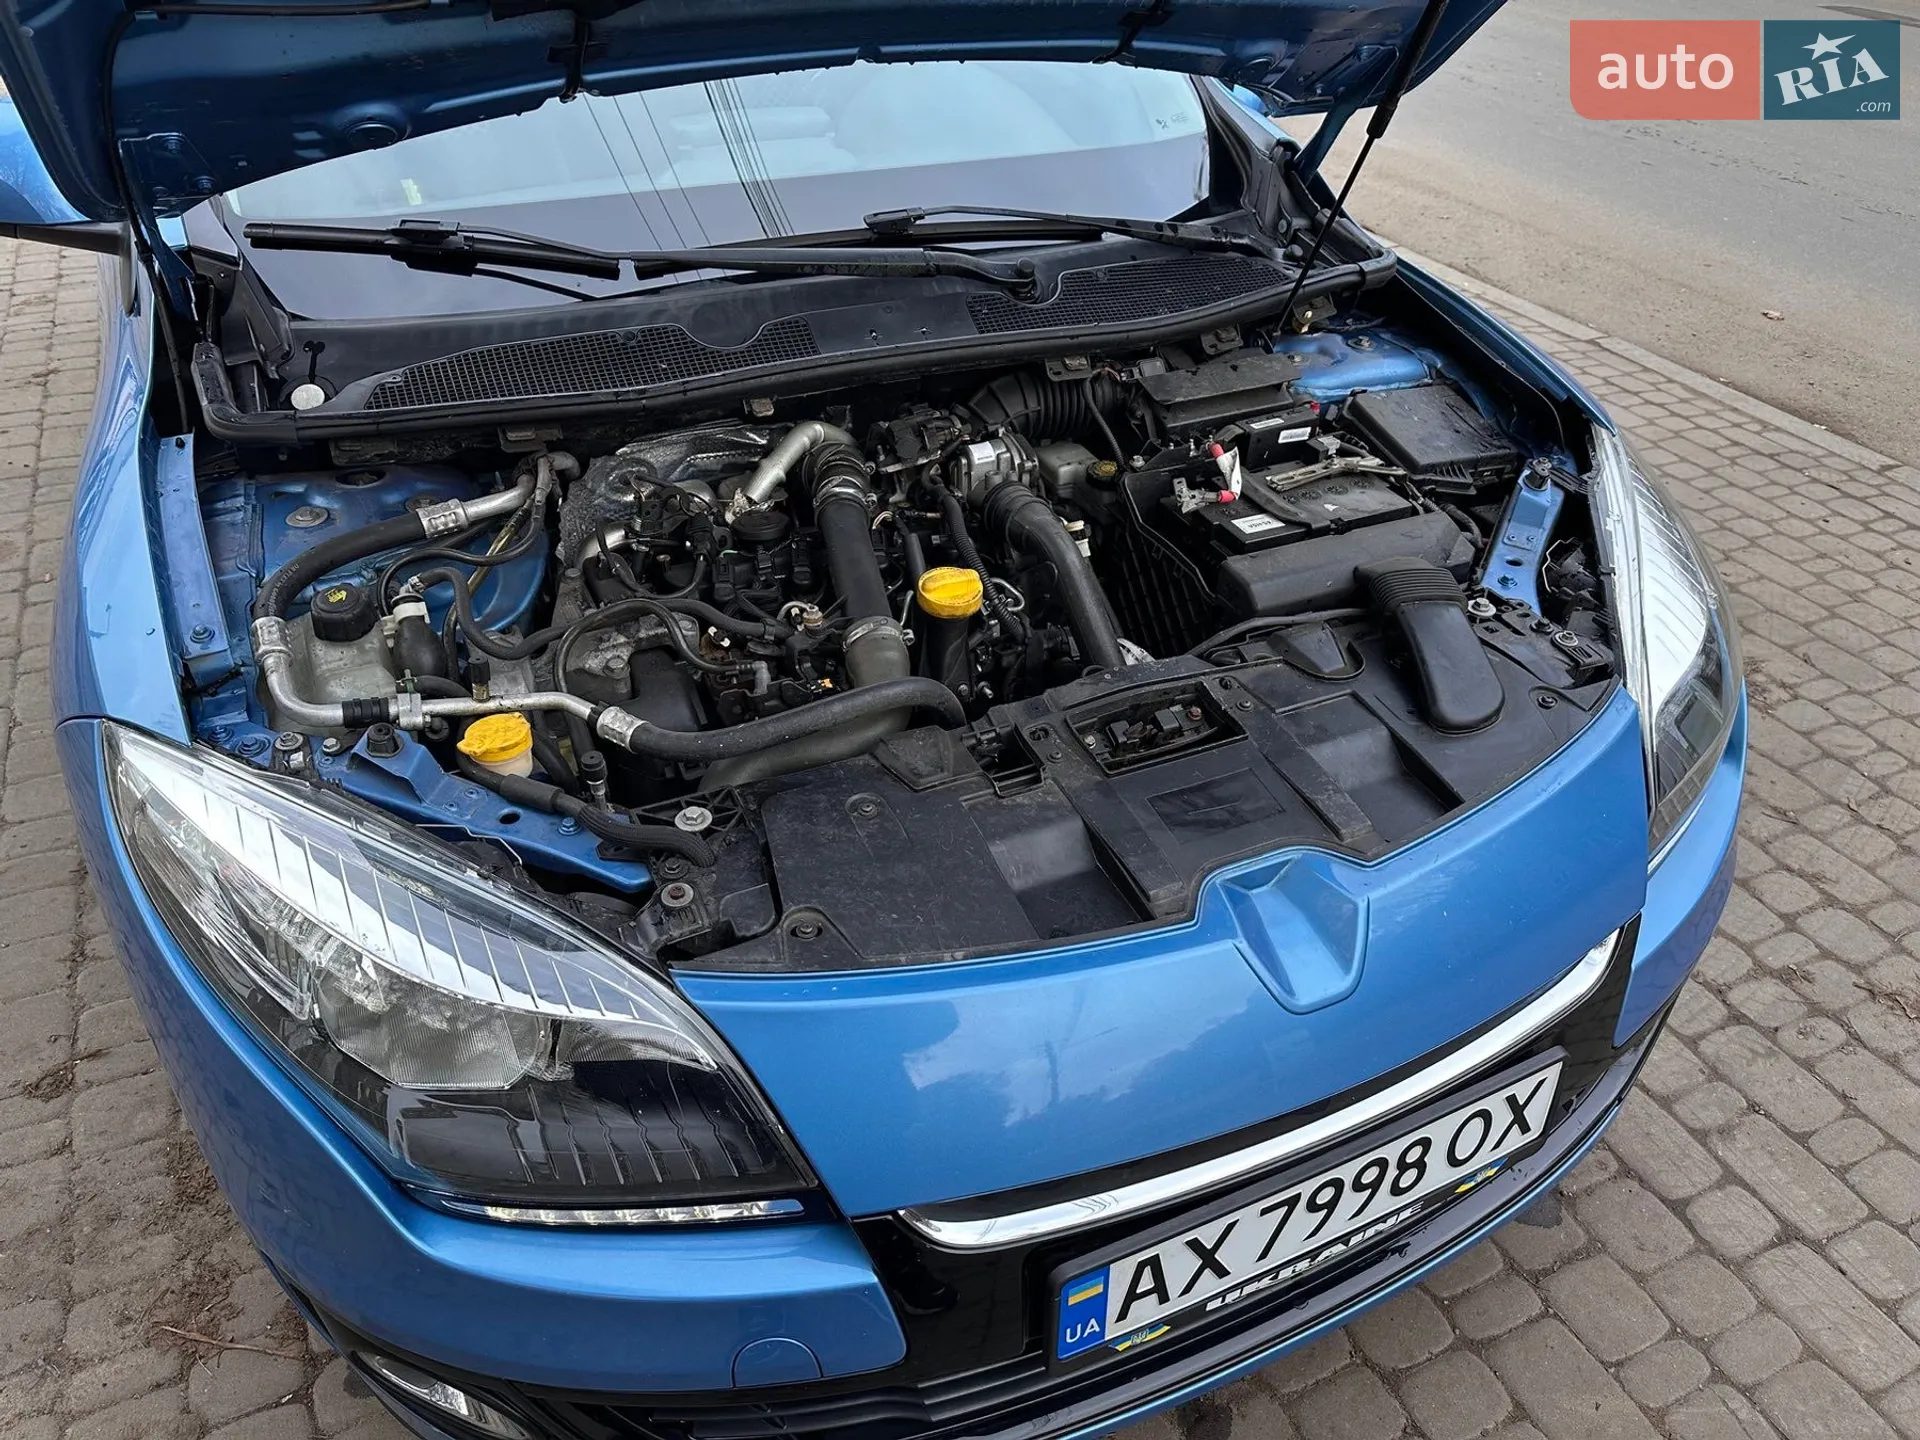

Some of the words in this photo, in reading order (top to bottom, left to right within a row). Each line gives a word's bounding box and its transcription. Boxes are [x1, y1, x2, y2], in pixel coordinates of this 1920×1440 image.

[1114, 1218, 1240, 1324] AX
[1255, 1136, 1433, 1263] 7998
[1446, 1076, 1549, 1168] OX
[1205, 1201, 1424, 1311] UKRAINE
[1065, 1317, 1101, 1344] UA
